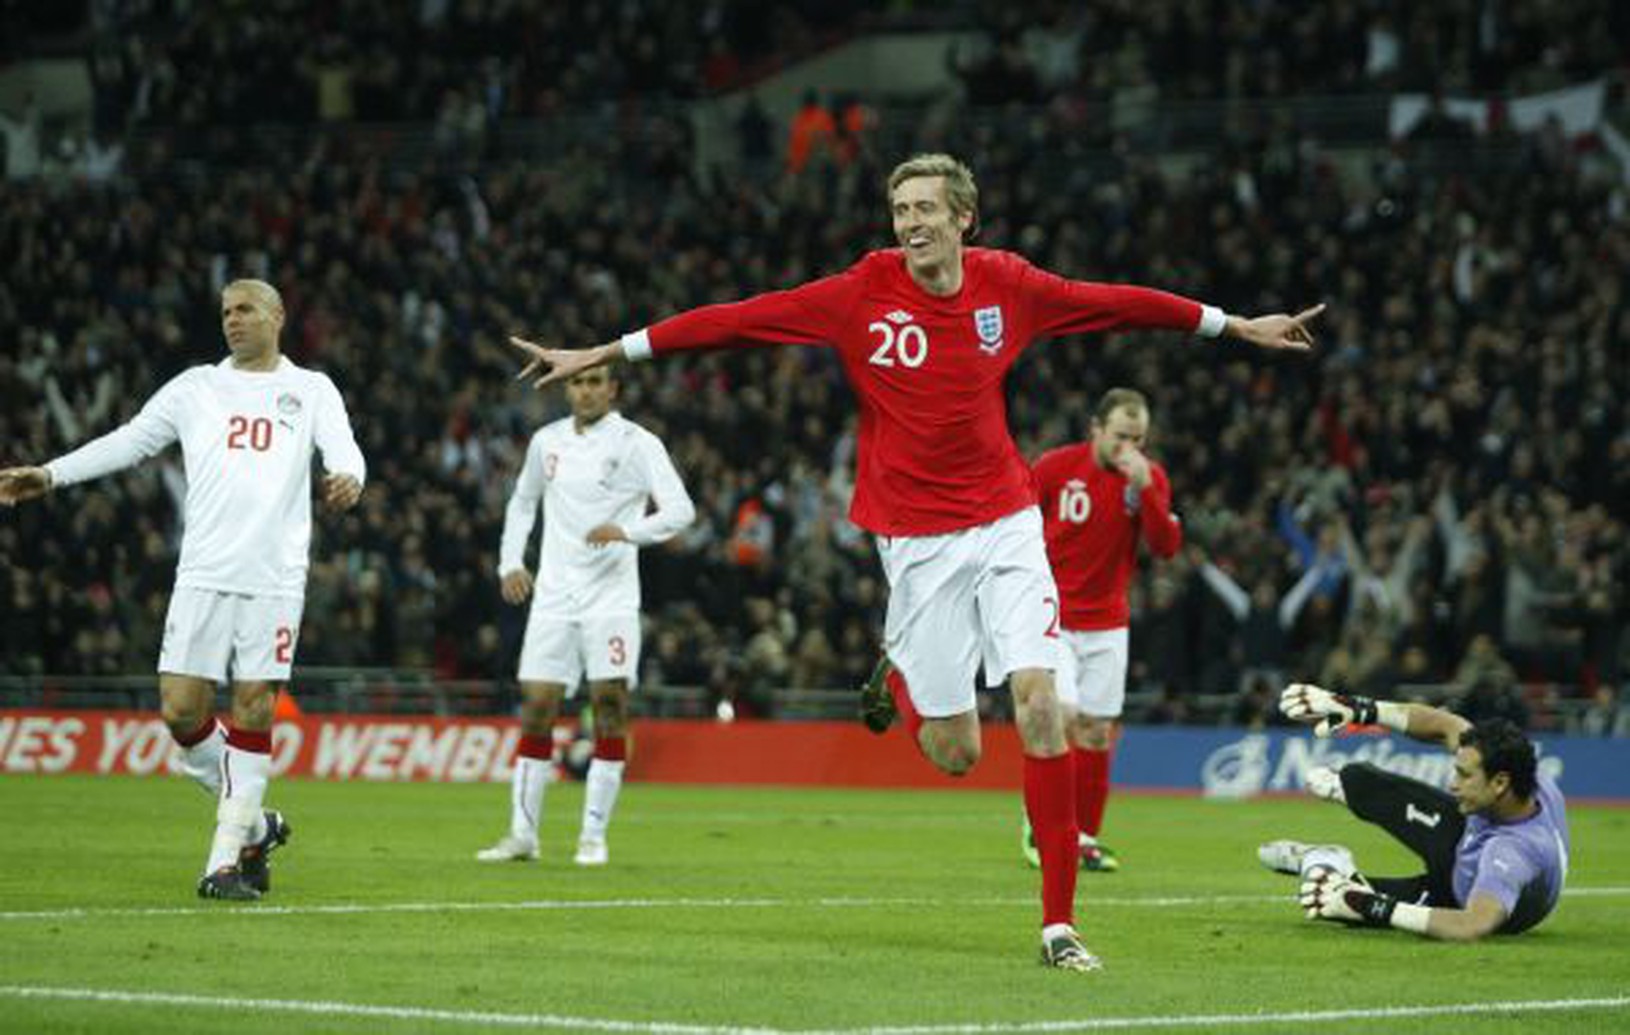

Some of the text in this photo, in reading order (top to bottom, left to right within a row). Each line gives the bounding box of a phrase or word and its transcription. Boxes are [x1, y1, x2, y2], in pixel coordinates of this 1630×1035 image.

[868, 321, 927, 368] 20
[227, 415, 273, 452] 20
[1058, 486, 1091, 523] 10
[1042, 597, 1060, 639] 2
[275, 627, 297, 664] 2
[607, 636, 626, 666] 3
[98, 718, 184, 776] YO
[312, 721, 571, 783] WEMBL
[1405, 802, 1442, 829] 1
